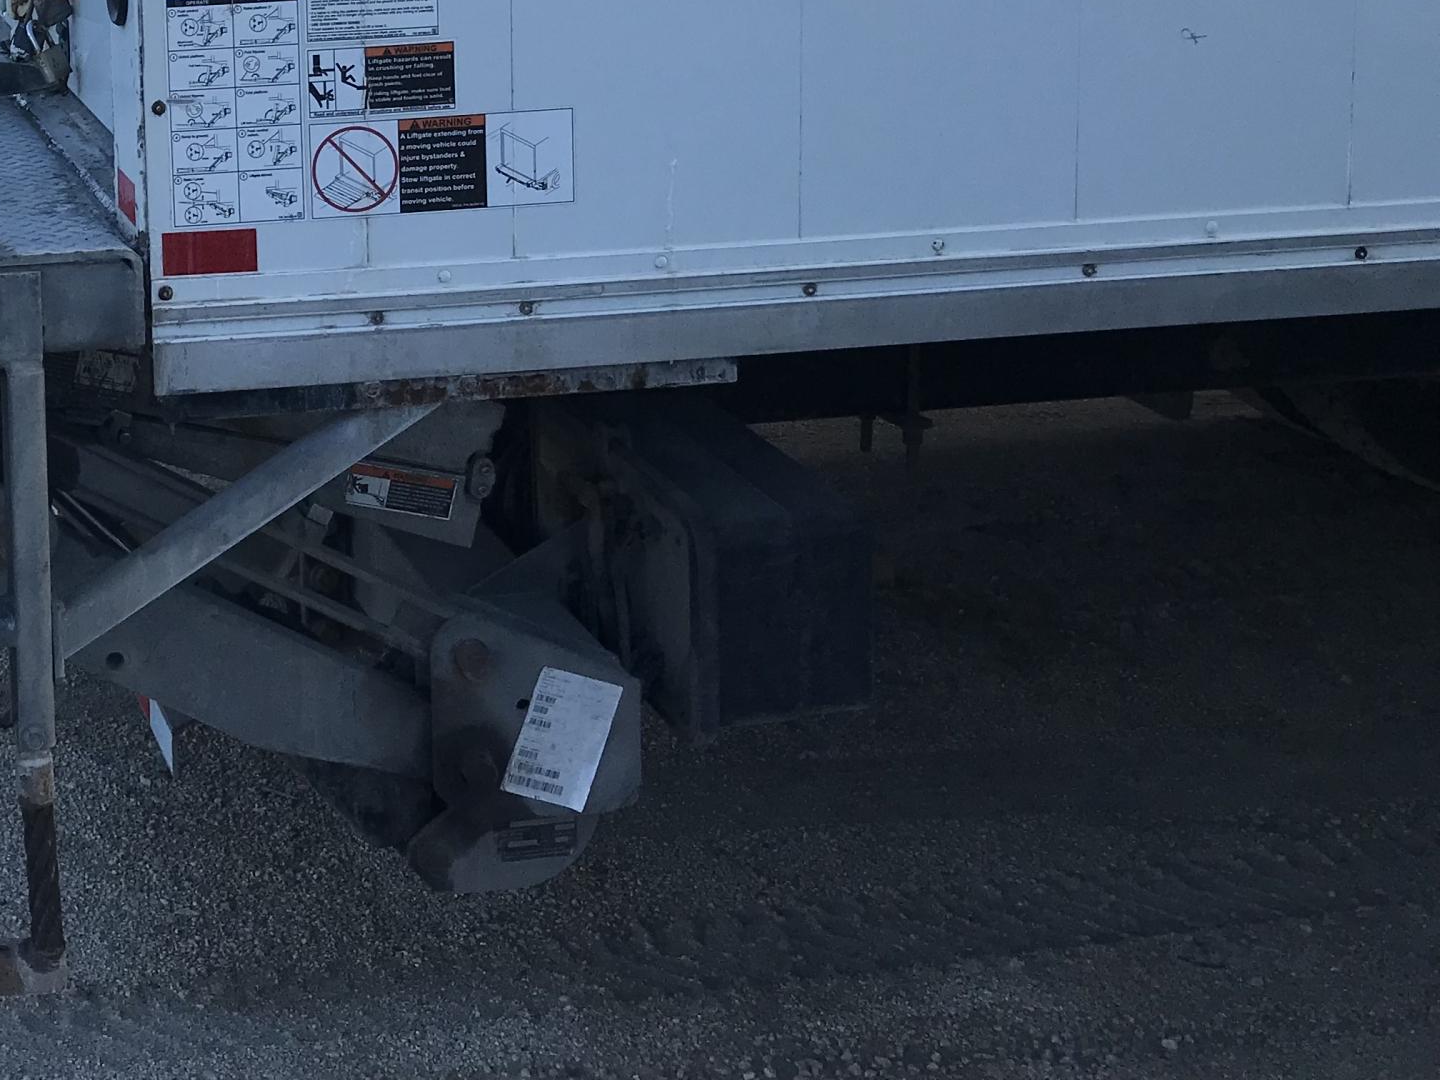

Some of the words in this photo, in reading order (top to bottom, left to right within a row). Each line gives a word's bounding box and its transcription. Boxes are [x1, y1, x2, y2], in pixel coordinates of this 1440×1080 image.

[394, 45, 437, 54] WARNING
[376, 64, 404, 72] crushing
[423, 118, 472, 128] WARNING
[433, 130, 466, 138] extending
[421, 152, 458, 160] bystanders
[419, 175, 443, 183] liftgate
[452, 172, 476, 180] correct
